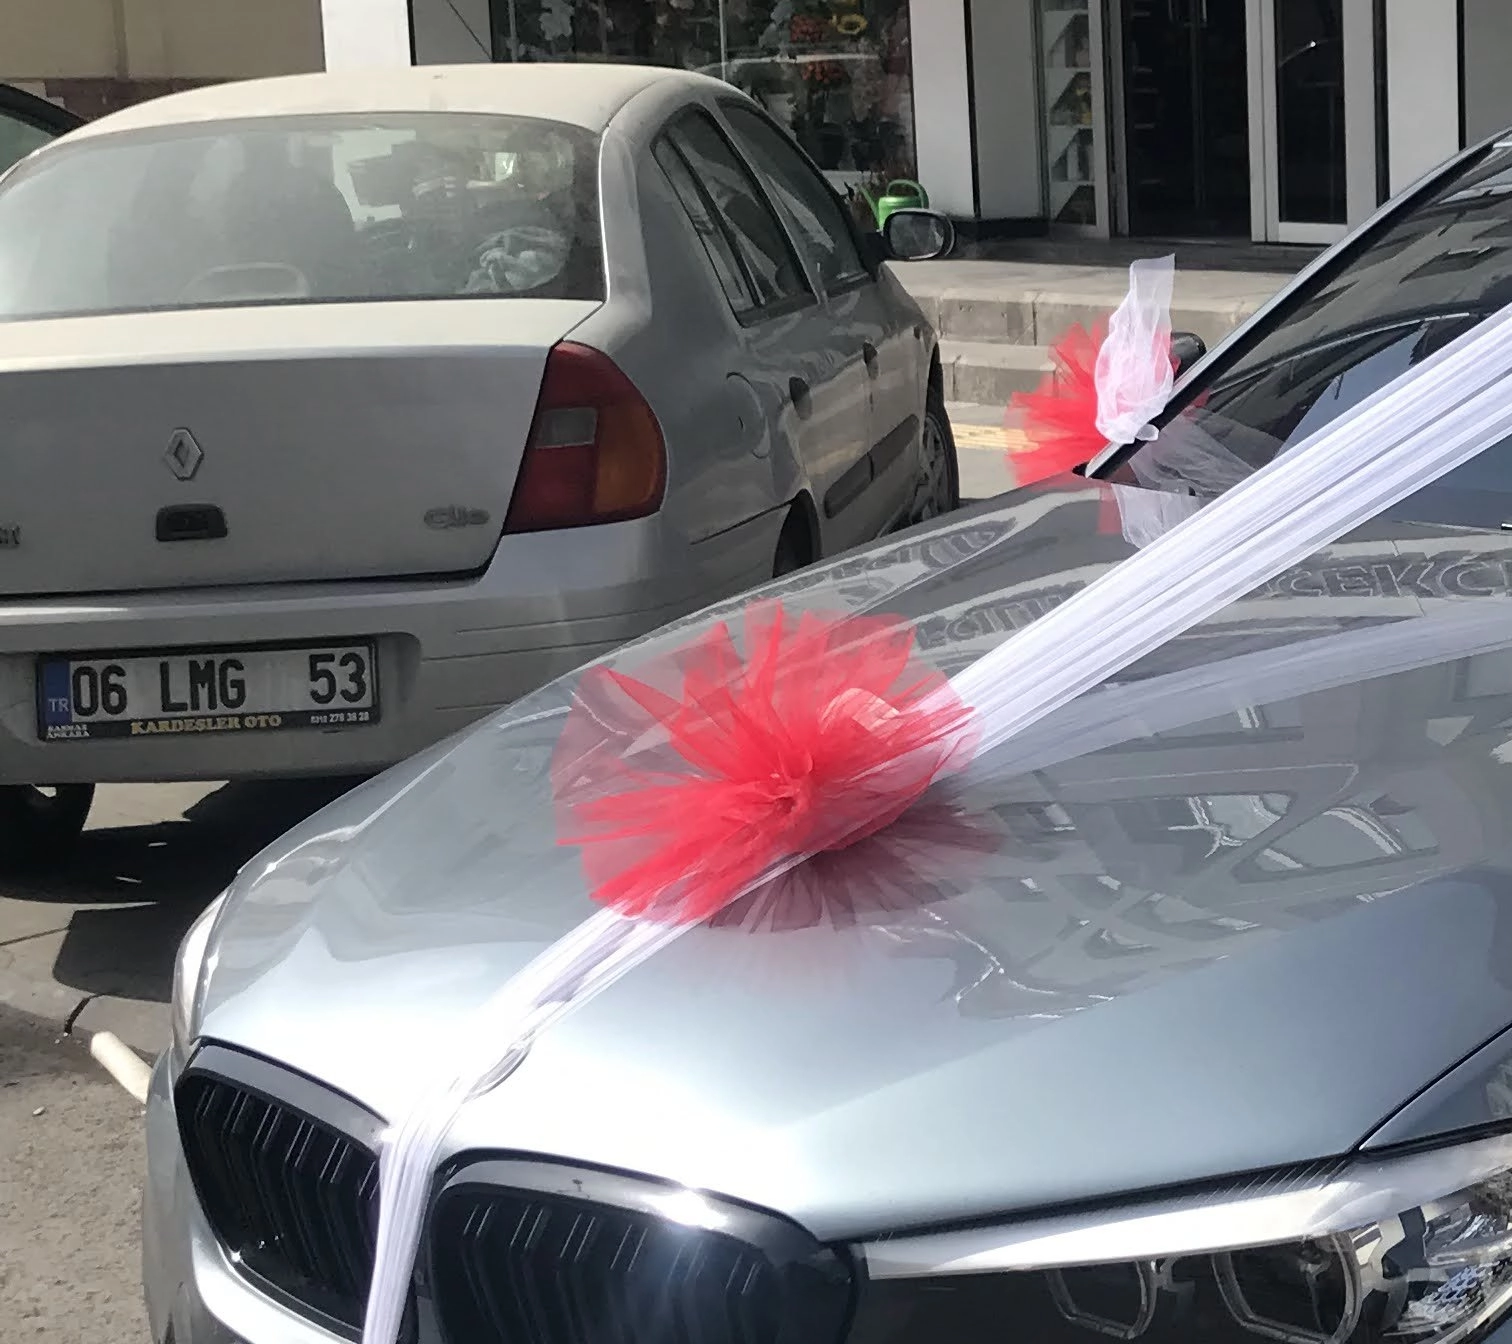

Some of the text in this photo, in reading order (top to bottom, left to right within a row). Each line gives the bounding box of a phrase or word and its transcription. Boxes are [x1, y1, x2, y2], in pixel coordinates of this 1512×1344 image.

[48, 652, 367, 718] TR 06 LMG 53
[244, 714, 283, 729] OTO
